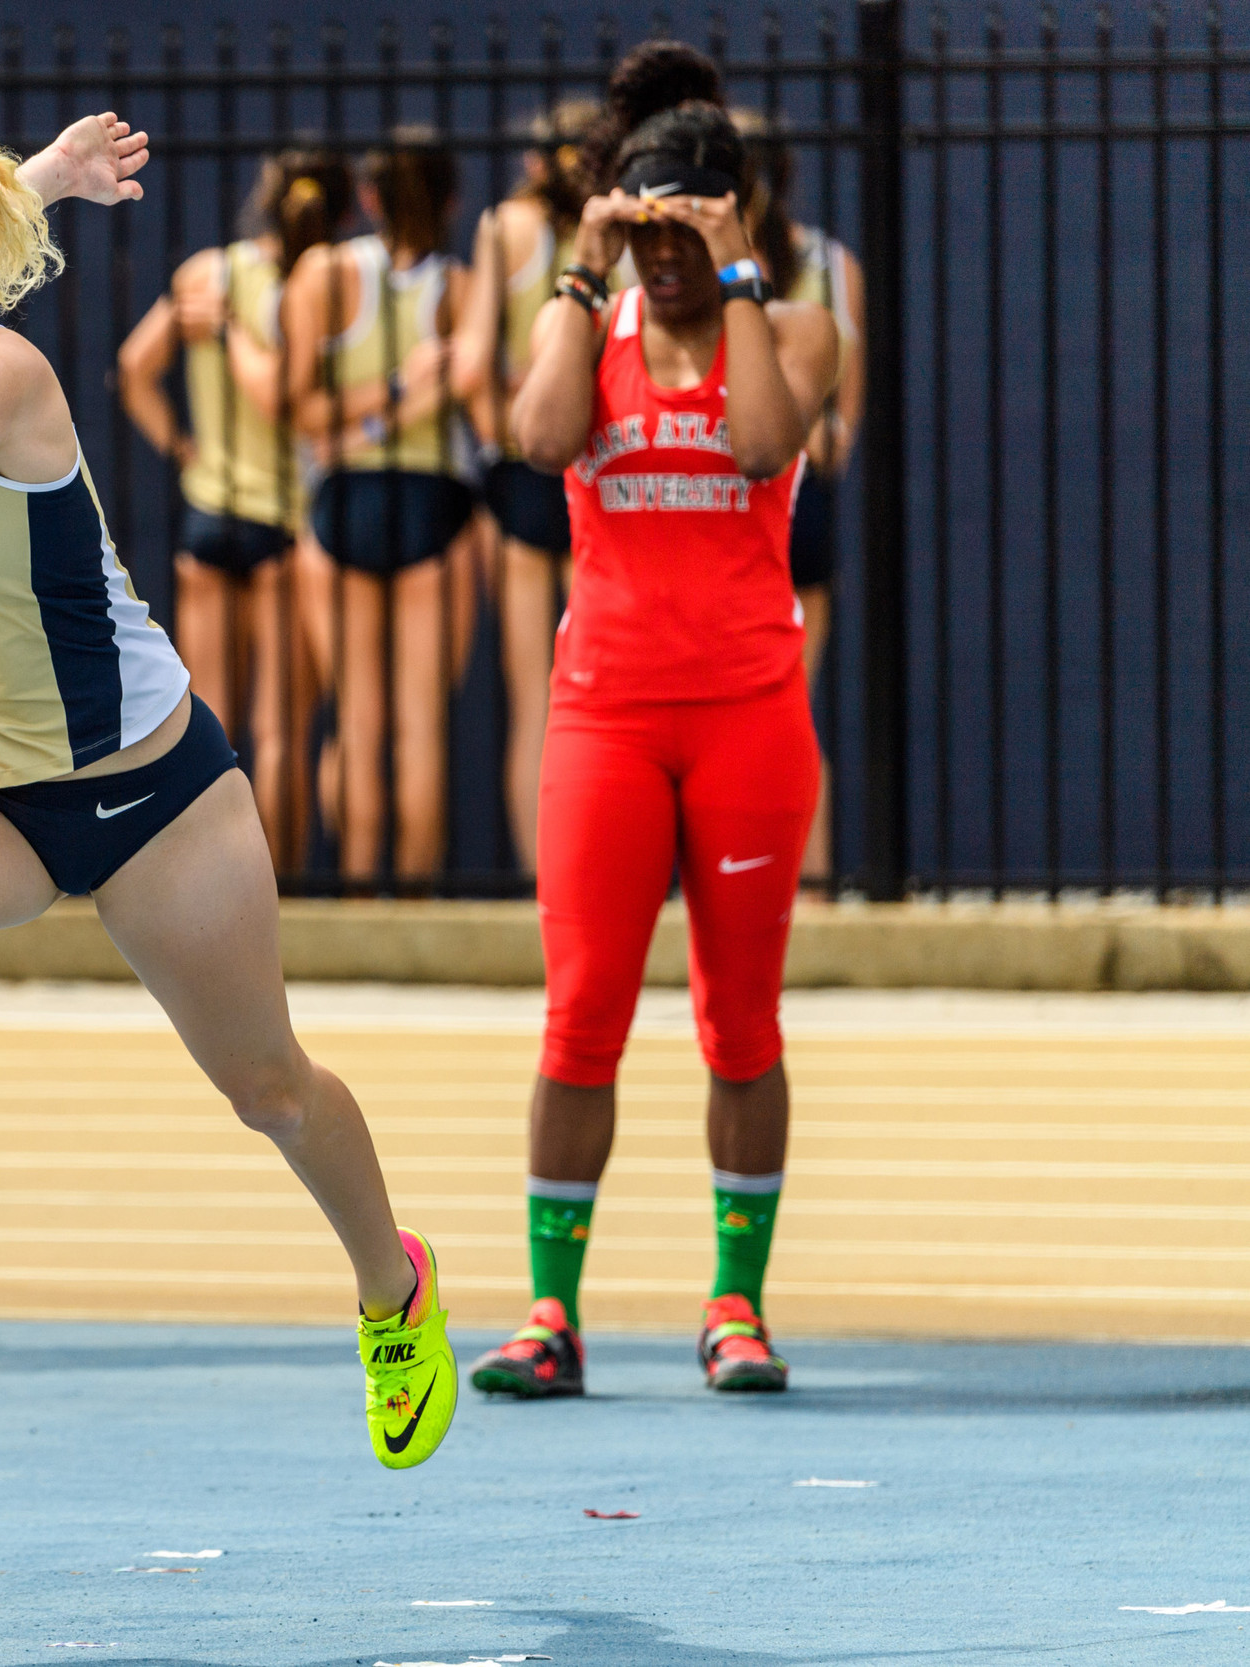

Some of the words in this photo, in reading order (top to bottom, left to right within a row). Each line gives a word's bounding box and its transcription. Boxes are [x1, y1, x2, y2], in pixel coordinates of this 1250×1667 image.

[652, 411, 732, 453] ATLA
[598, 473, 750, 512] UNIVERSITY
[371, 1343, 416, 1364] NIKE
